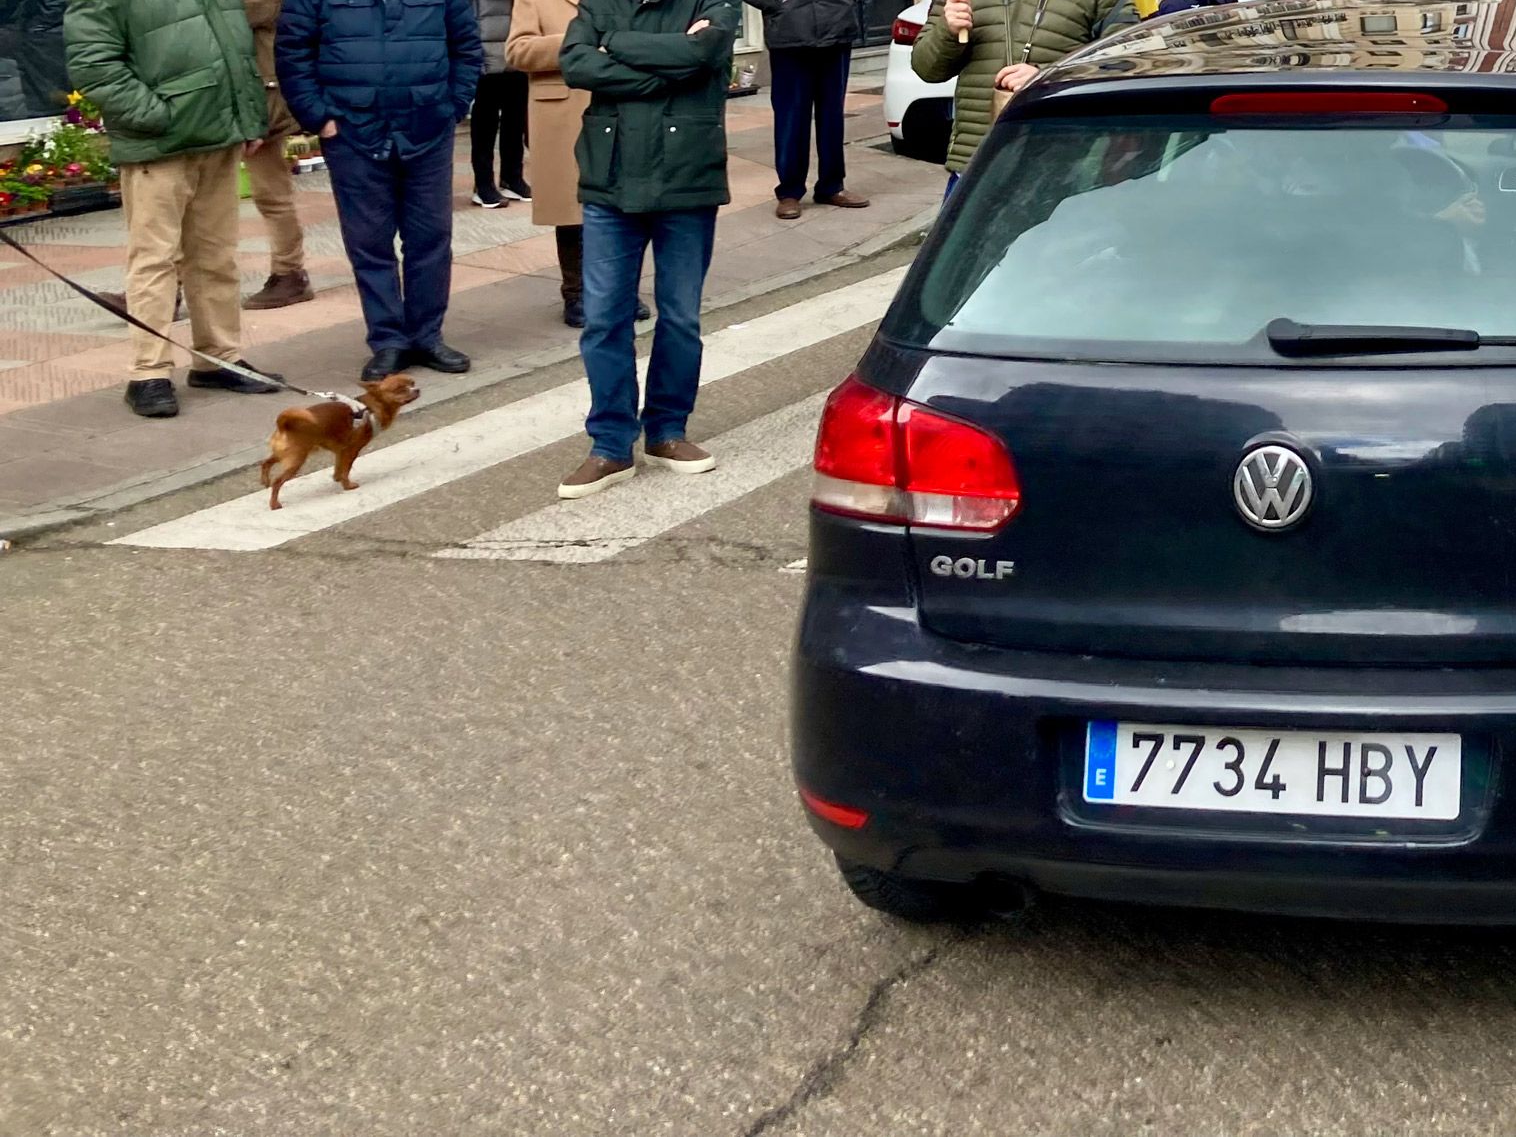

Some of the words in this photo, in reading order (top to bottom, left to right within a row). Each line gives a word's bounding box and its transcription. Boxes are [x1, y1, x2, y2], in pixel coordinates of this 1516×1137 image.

[930, 555, 1015, 580] GOLF
[1096, 769, 1107, 785] E
[1130, 732, 1287, 800] 7734
[1316, 741, 1437, 807] HBY
